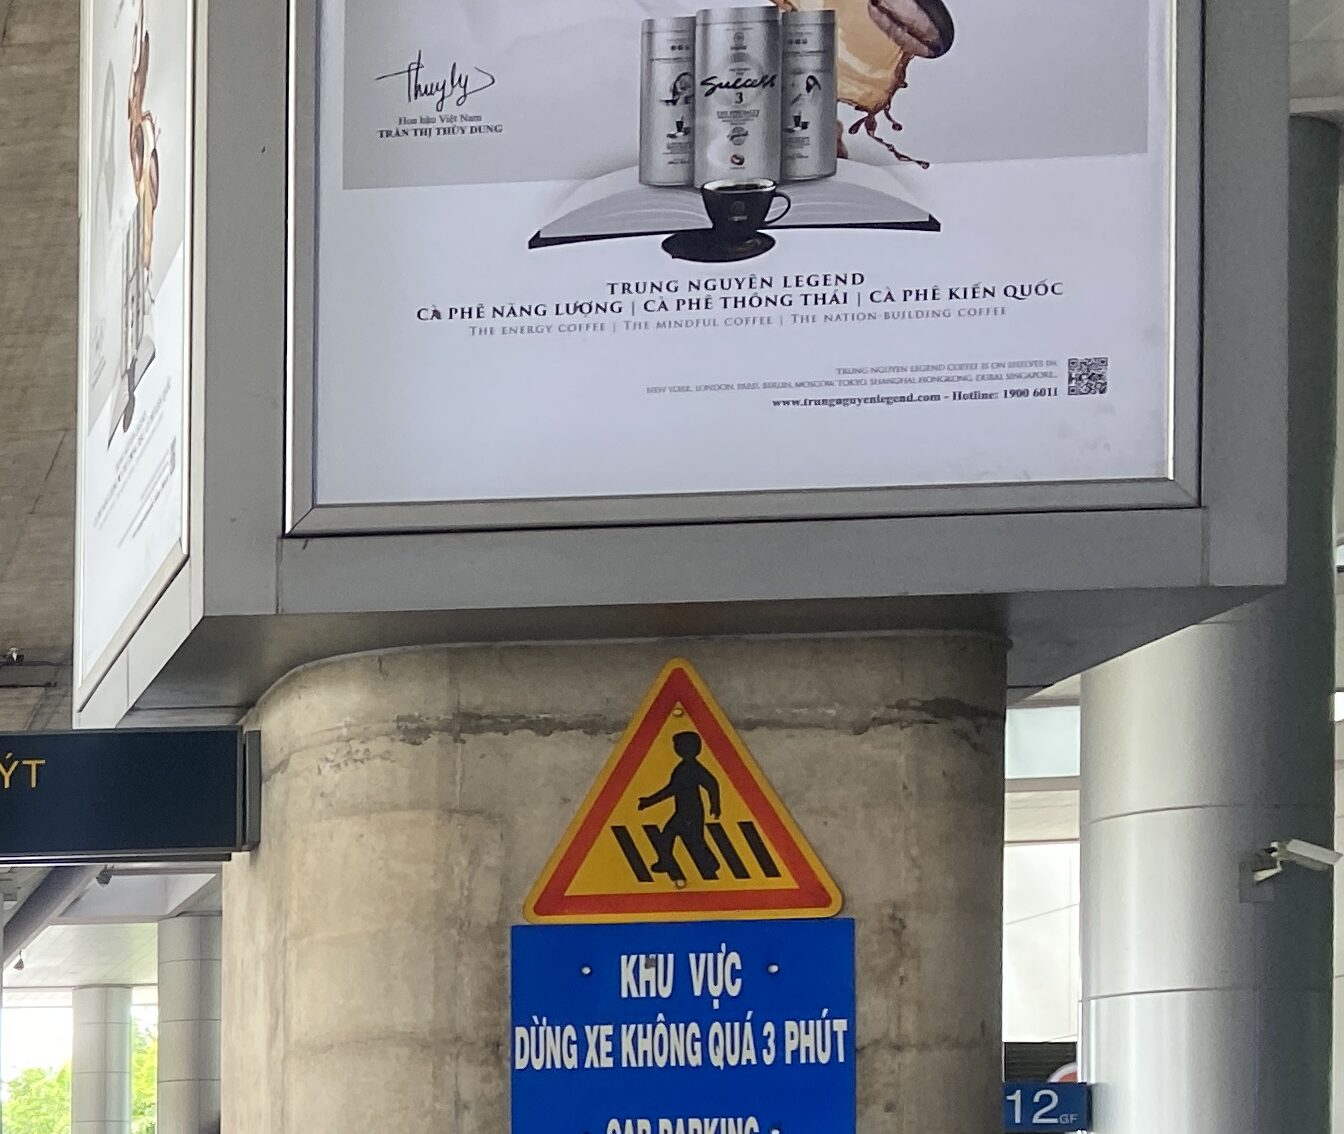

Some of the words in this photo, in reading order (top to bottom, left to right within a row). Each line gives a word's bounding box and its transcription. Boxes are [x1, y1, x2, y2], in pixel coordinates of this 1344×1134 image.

[417, 304, 442, 320] CÀ
[448, 302, 486, 320] PHÊ
[492, 301, 548, 319] NĂNG
[555, 299, 624, 318] LƯỢNG
[643, 295, 669, 313] CÀ
[676, 294, 714, 312] PHÊ
[719, 291, 794, 309] THÔNG
[800, 289, 849, 305] THÁI
[869, 287, 895, 304] CÀ
[903, 285, 941, 302] PHÊ
[948, 282, 996, 300] KIẾN
[1003, 279, 1064, 301] QUỐC
[607, 279, 680, 295] TRUNG
[687, 274, 773, 293] NGUYÊN
[783, 272, 865, 288] LEGEND
[502, 324, 552, 335] ENERGY
[558, 322, 606, 334] COFFEE
[656, 318, 719, 329] MINDFUL
[724, 315, 774, 327] COFFEE
[823, 309, 953, 322] NATION-BUILDING
[958, 306, 1008, 318] COFFEE
[1003, 388, 1030, 399] 1900
[1032, 387, 1058, 398] 6011
[620, 952, 674, 999] KHU
[688, 942, 742, 1010] VỰC
[514, 1015, 578, 1070] DỪNG
[584, 1023, 614, 1069] XE
[620, 1012, 702, 1069] KHÔNG
[708, 1010, 758, 1071] QUÁ
[762, 1021, 776, 1066] 3
[784, 1008, 849, 1065] PHÚT
[1005, 1088, 1060, 1124] 12
[1059, 1113, 1080, 1125] GF
